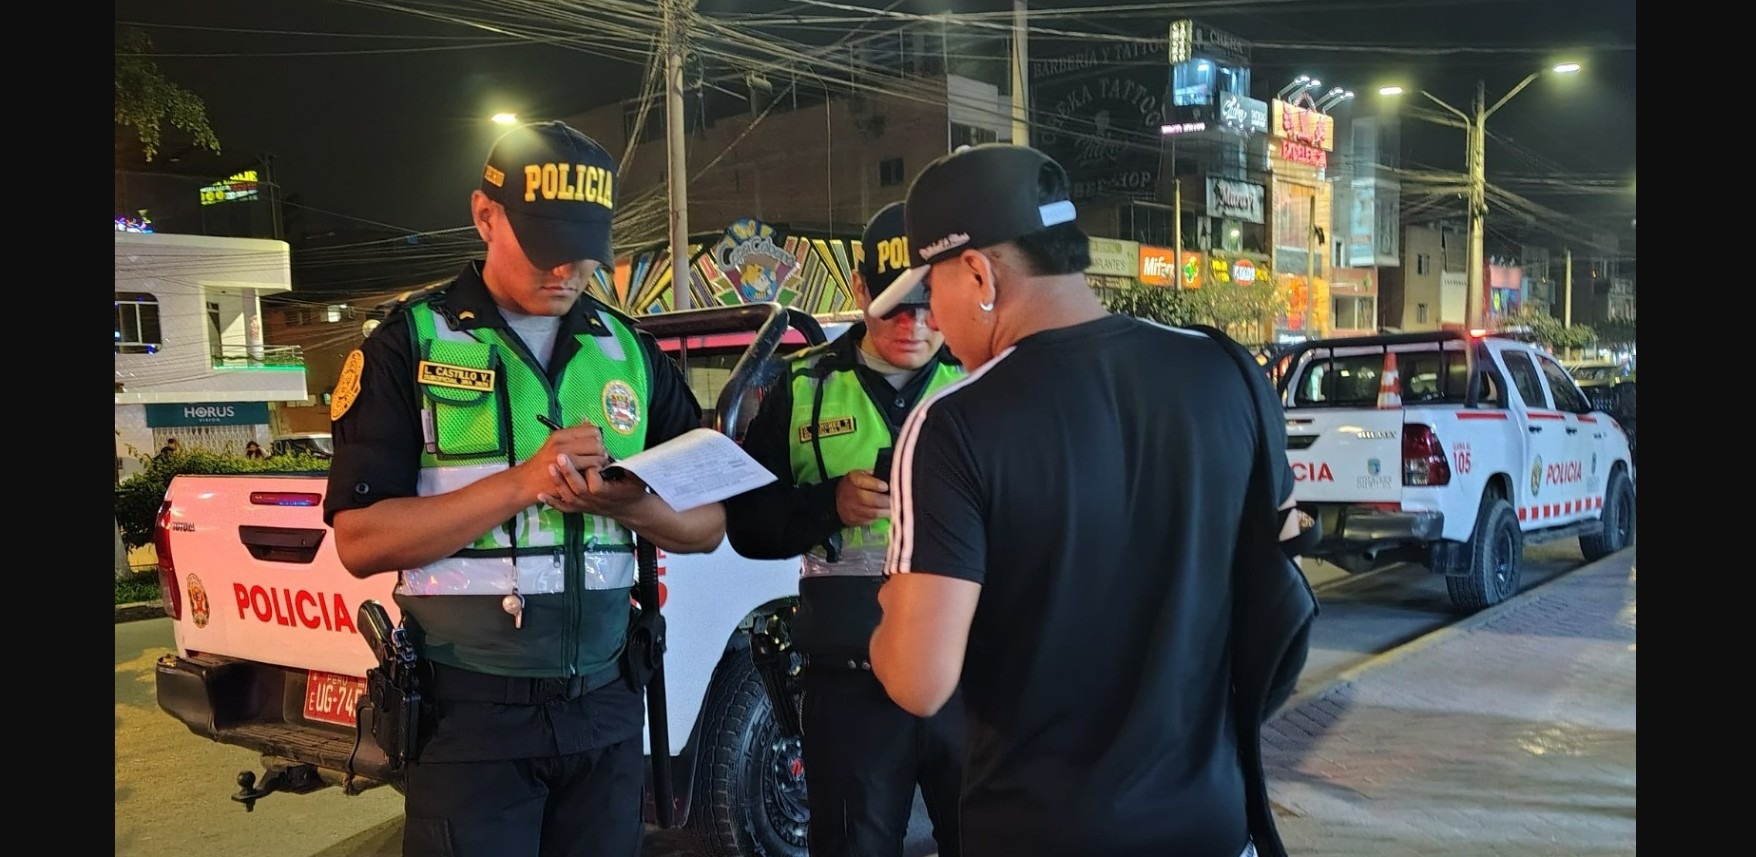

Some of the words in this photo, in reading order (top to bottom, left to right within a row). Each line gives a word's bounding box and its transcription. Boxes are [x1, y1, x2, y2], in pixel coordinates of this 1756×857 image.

[524, 163, 613, 209] POLICIA
[435, 366, 477, 380] CASTILLO
[184, 406, 235, 418] HORUS
[1546, 460, 1582, 485] POLICIA
[233, 583, 357, 634] POLICIA
